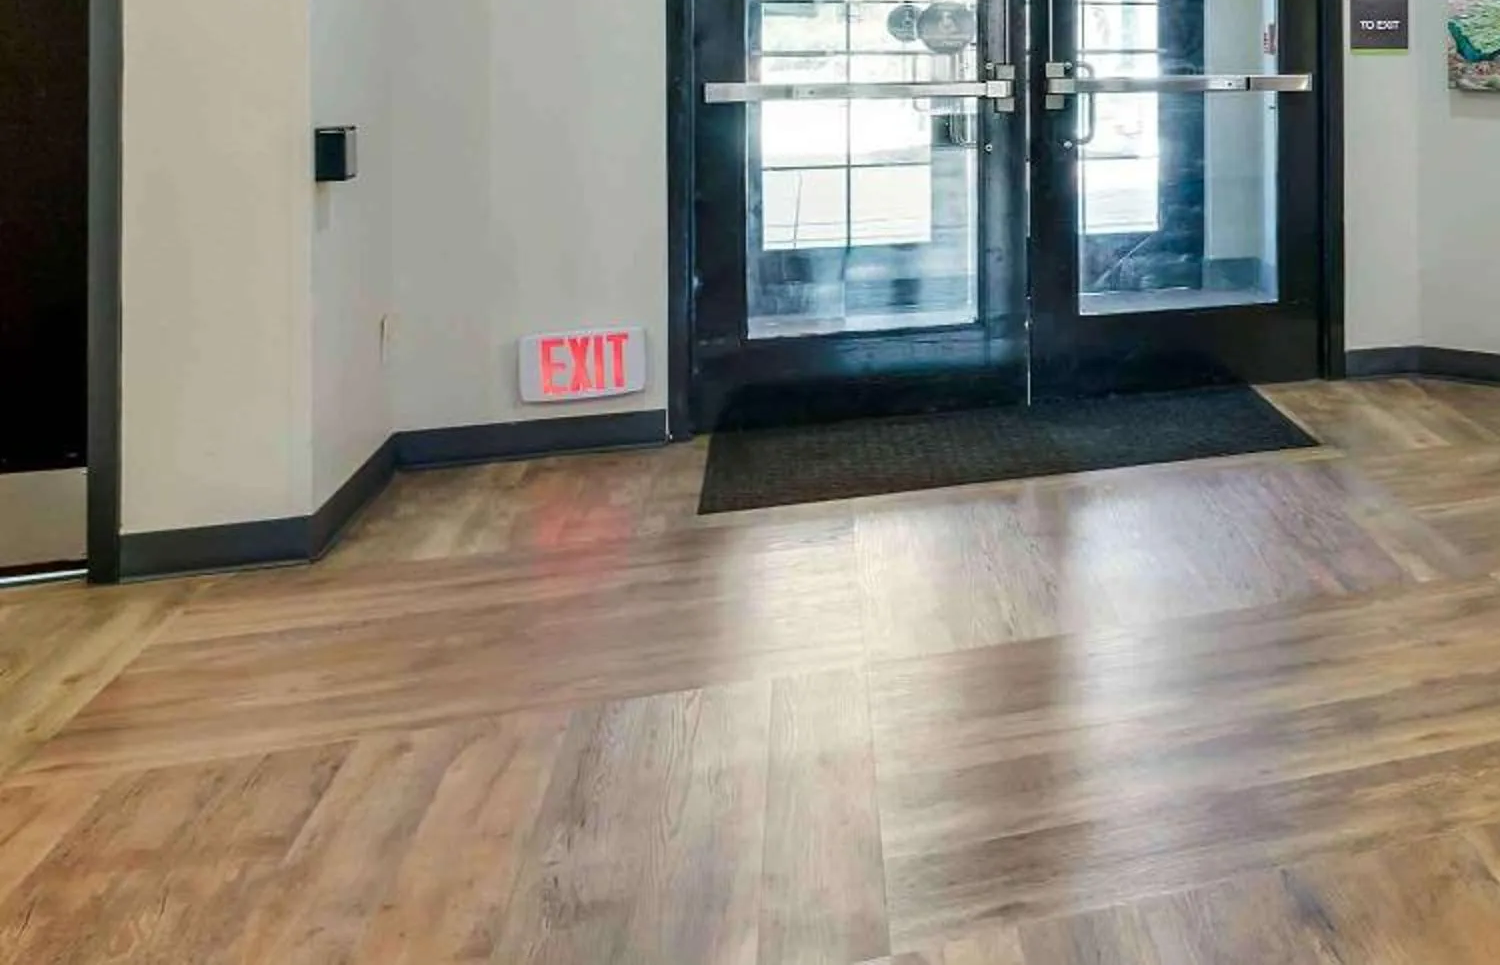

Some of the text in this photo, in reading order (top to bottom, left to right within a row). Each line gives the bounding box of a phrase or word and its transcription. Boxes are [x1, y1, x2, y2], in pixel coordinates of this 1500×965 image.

[1360, 20, 1400, 30] TO EXIT
[540, 333, 629, 394] EXIT
